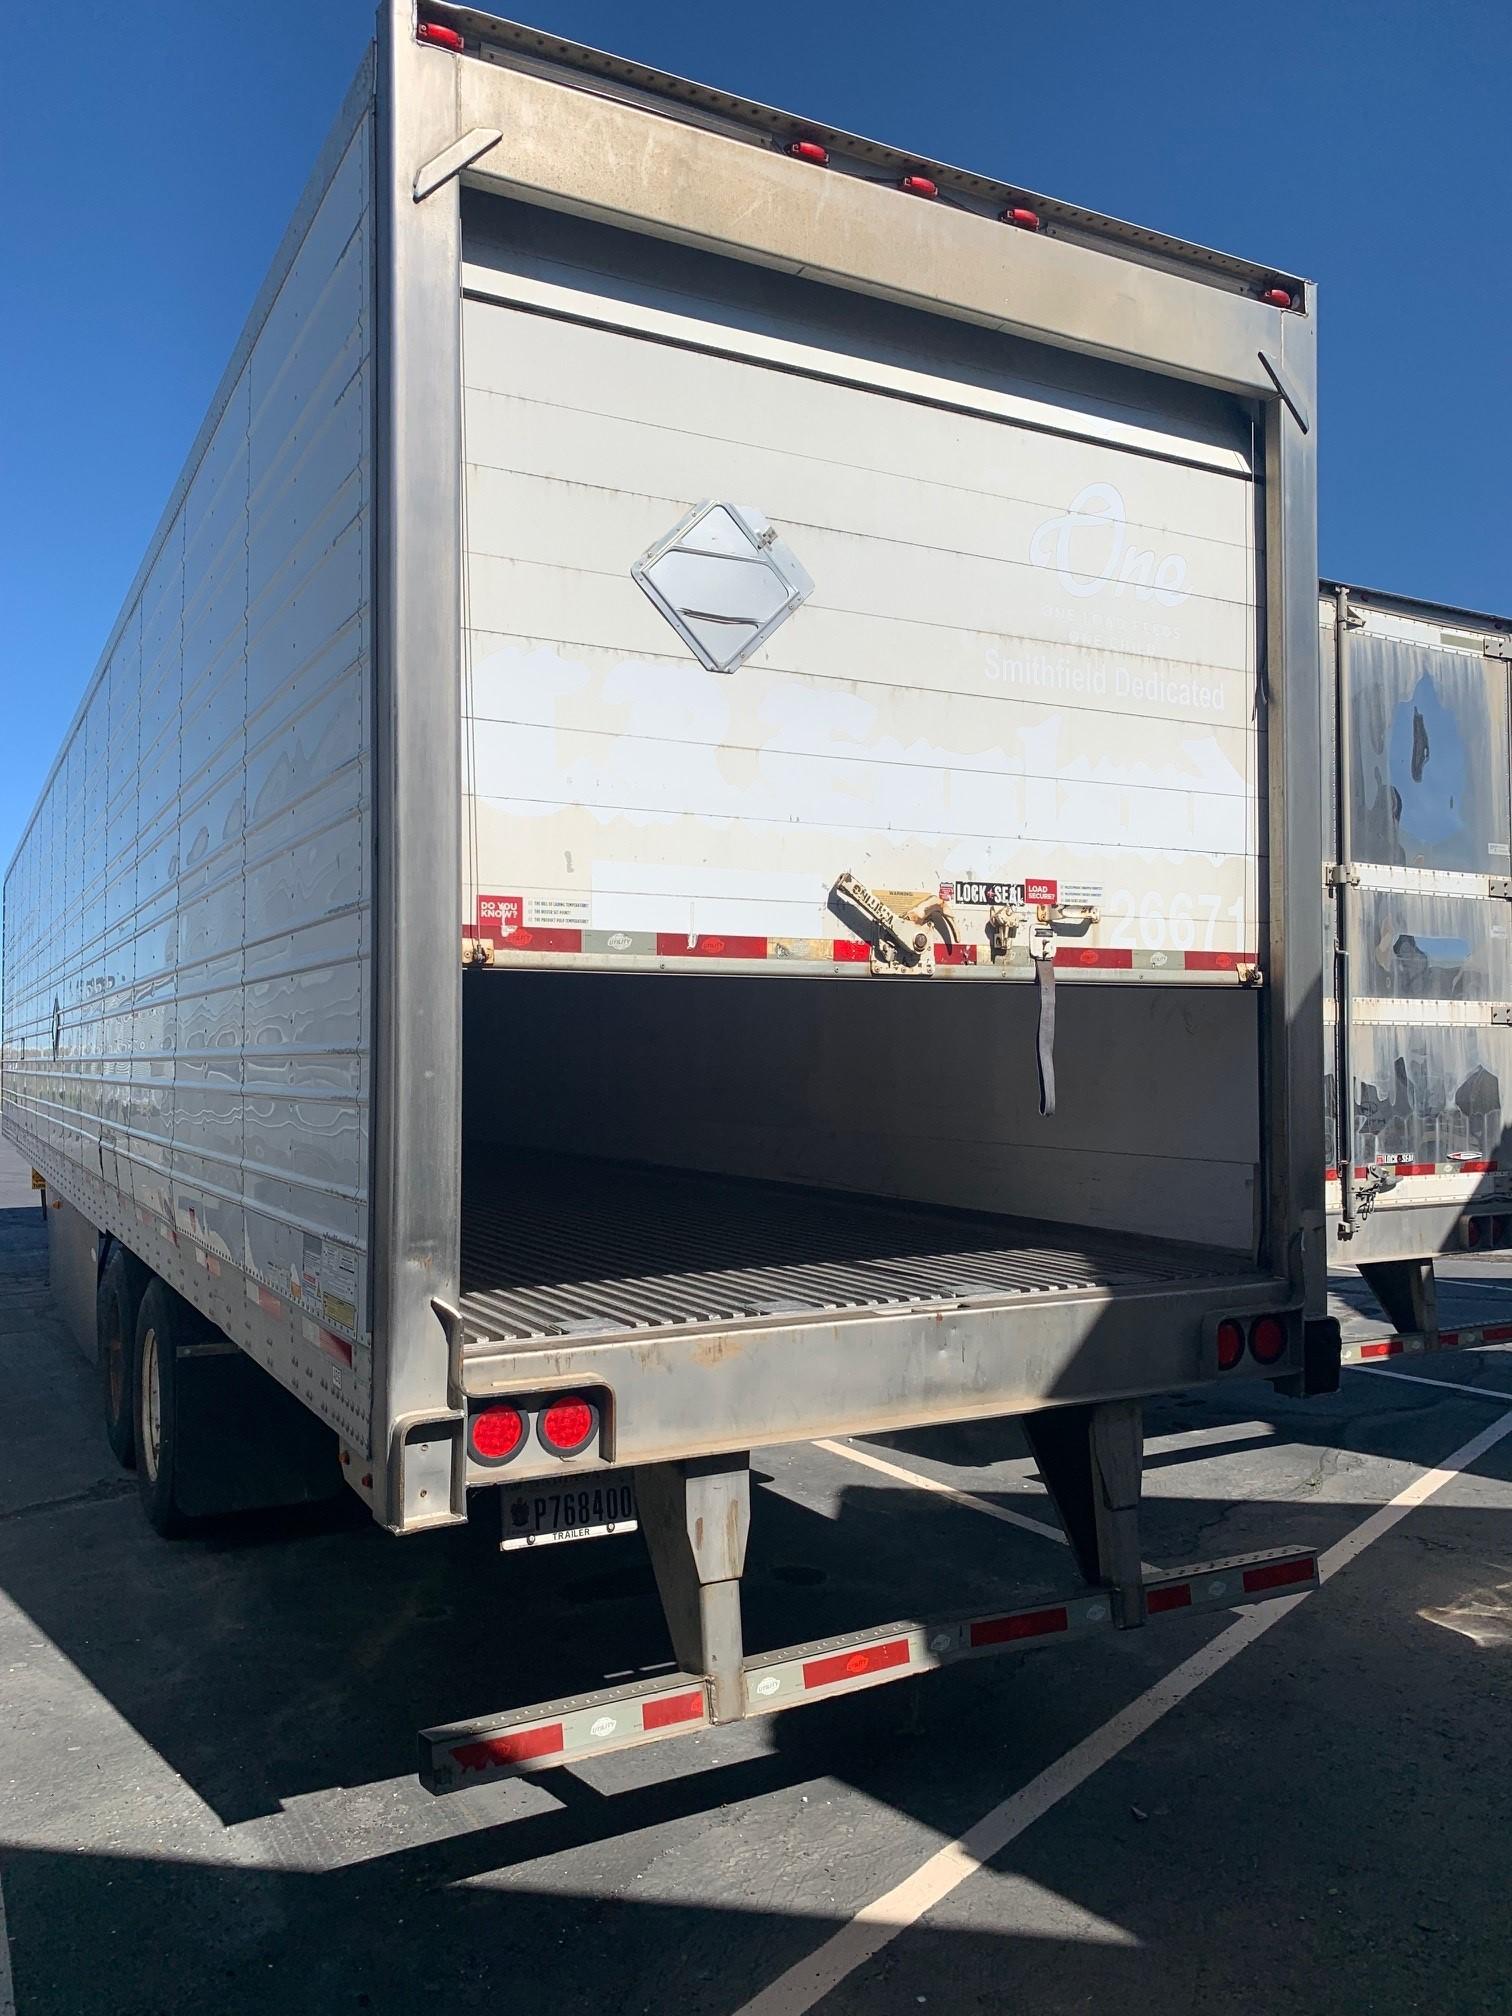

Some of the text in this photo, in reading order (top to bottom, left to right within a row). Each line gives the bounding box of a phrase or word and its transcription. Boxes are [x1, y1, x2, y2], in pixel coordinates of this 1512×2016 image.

[1029, 482, 1194, 607] One
[984, 647, 1226, 712] Smithfield Dedicated
[956, 882, 987, 903] LOCK
[993, 884, 1024, 905] SEAL
[1028, 885, 1048, 893] LOAD
[1028, 892, 1056, 901] SECURE?
[480, 909, 518, 919] KNOW?
[481, 901, 518, 911] DO YOU
[1110, 889, 1245, 952] 26671
[534, 1486, 632, 1530] P768400
[552, 1528, 590, 1541] TRAILER
